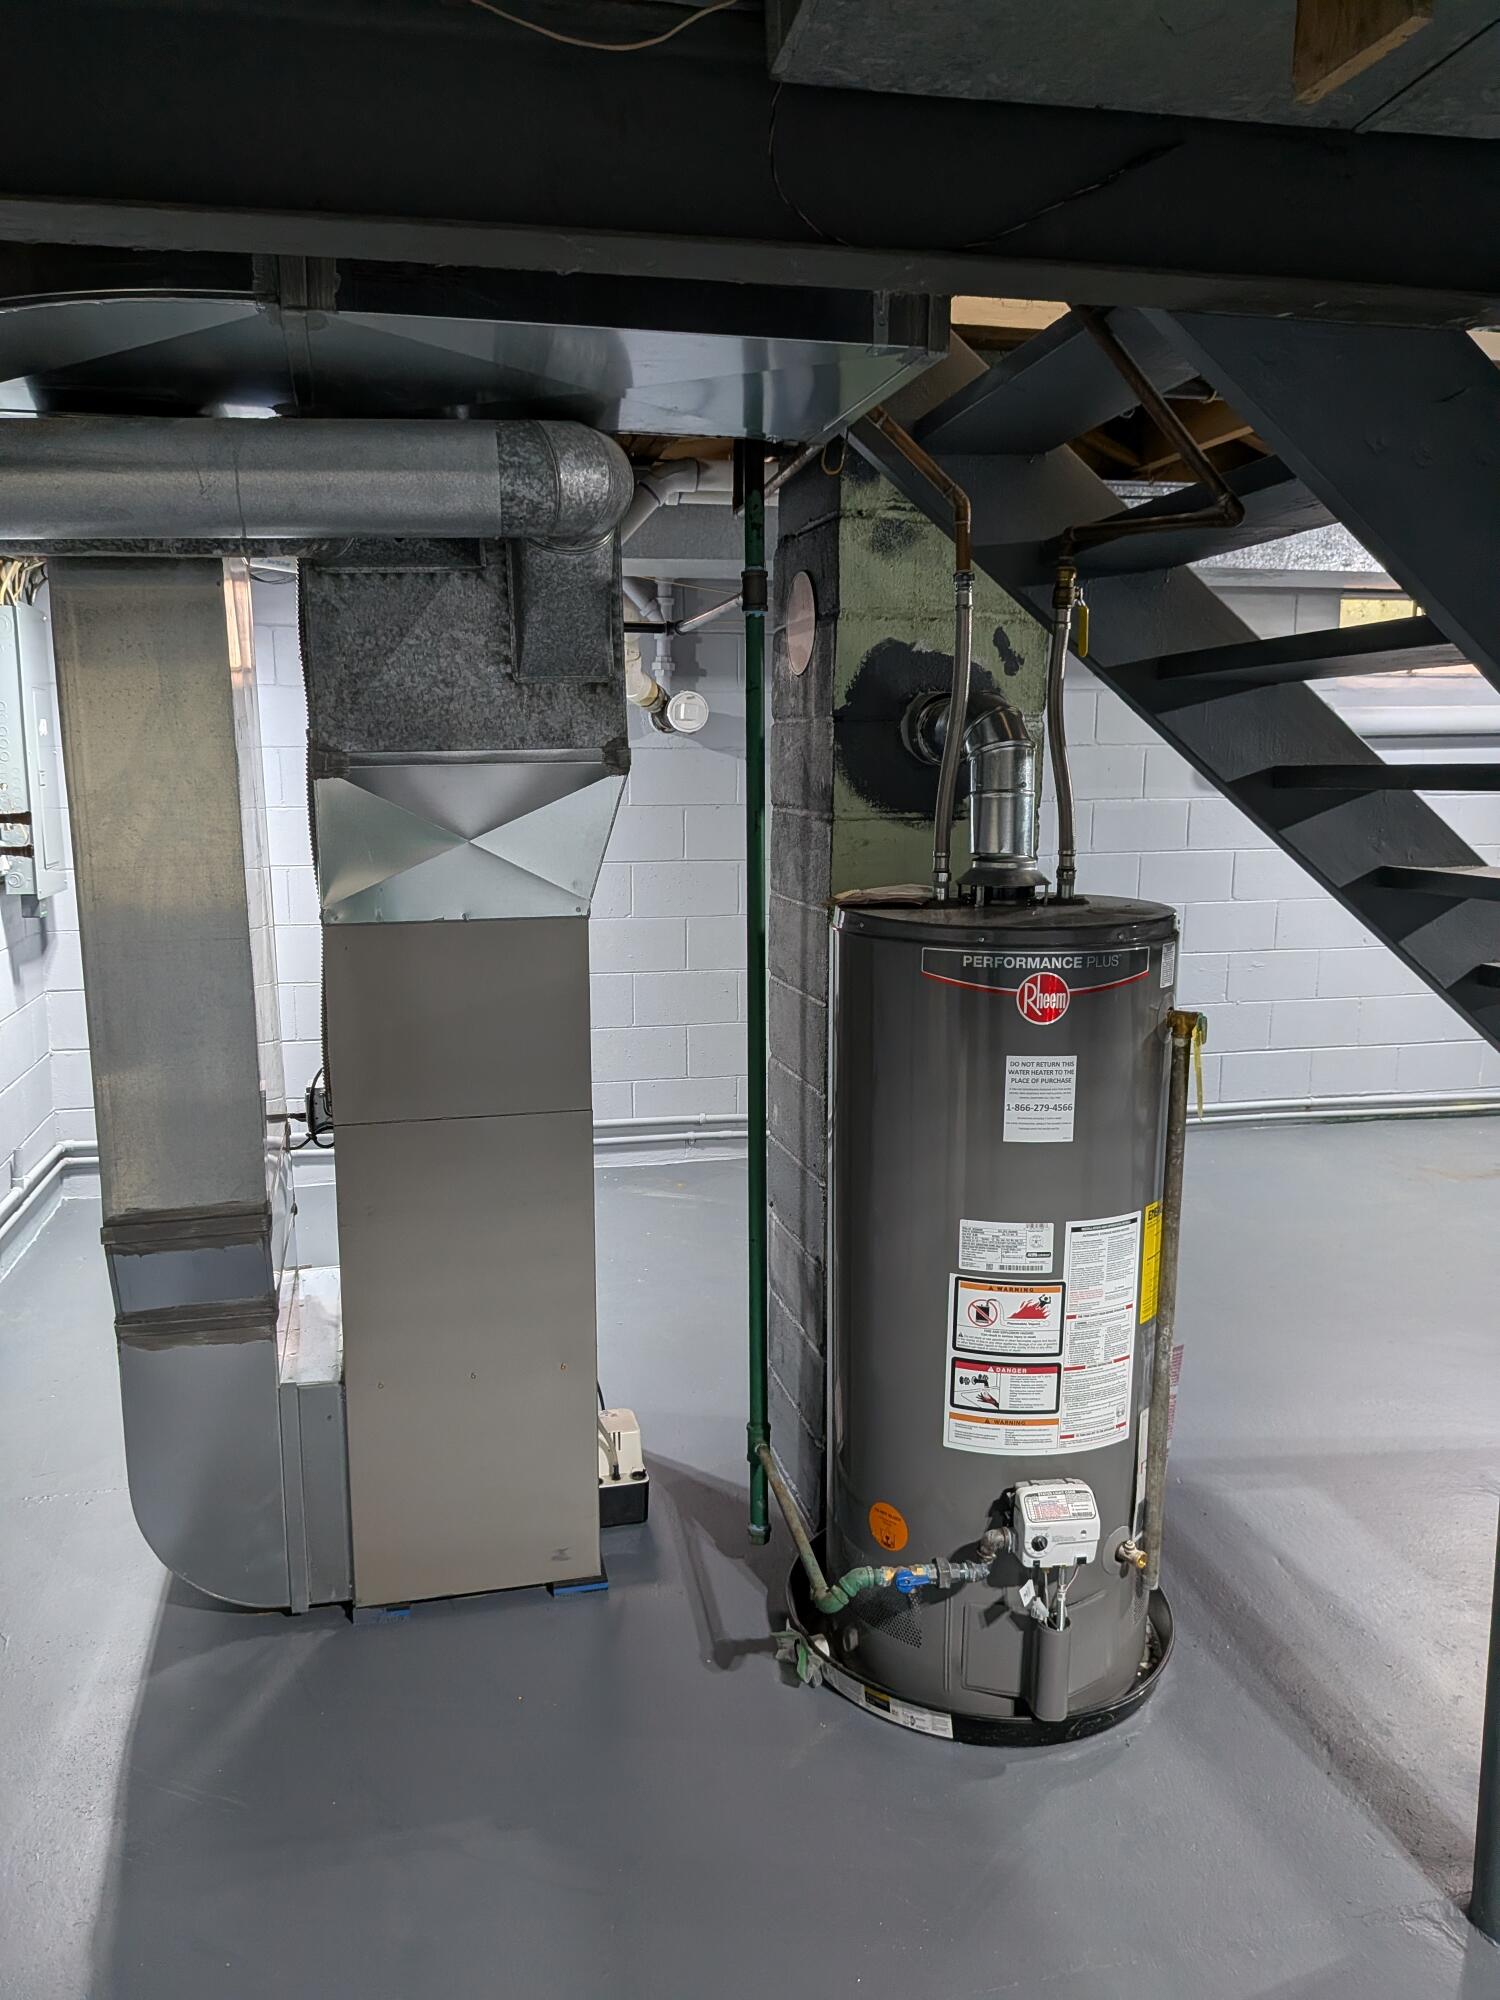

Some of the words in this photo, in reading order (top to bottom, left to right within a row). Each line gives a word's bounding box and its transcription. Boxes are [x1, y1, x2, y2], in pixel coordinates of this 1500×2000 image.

[963, 955, 1083, 968] PERFORMANCE
[1024, 975, 1066, 1016] Rheem
[1006, 1103, 1073, 1112] 1-866-279-4566
